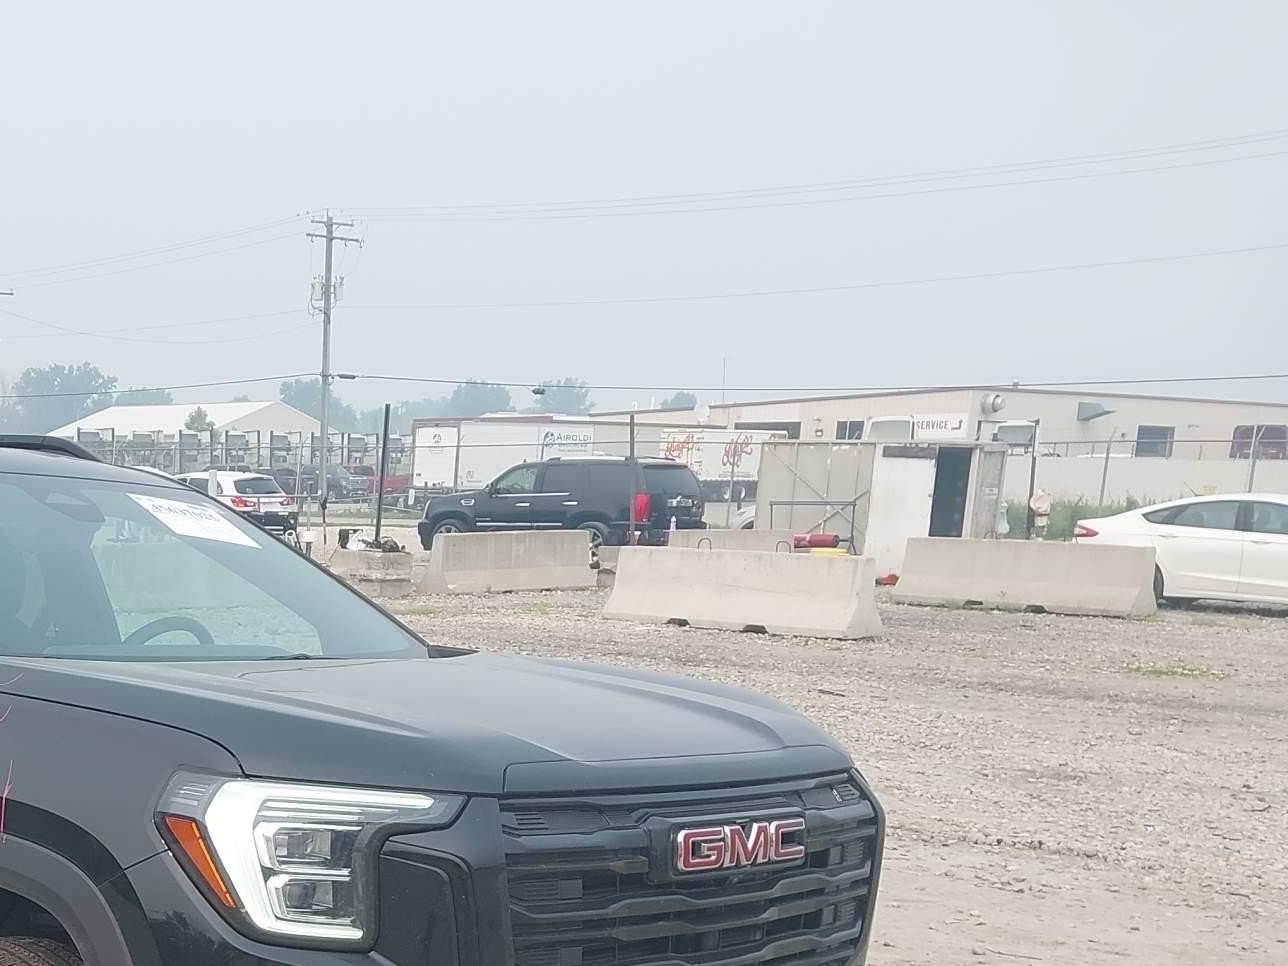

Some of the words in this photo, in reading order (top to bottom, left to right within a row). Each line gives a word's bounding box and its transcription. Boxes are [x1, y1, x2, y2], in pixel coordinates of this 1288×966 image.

[916, 419, 949, 431] SERVICE
[556, 432, 592, 442] AIROLDI
[677, 818, 807, 872] GMC
